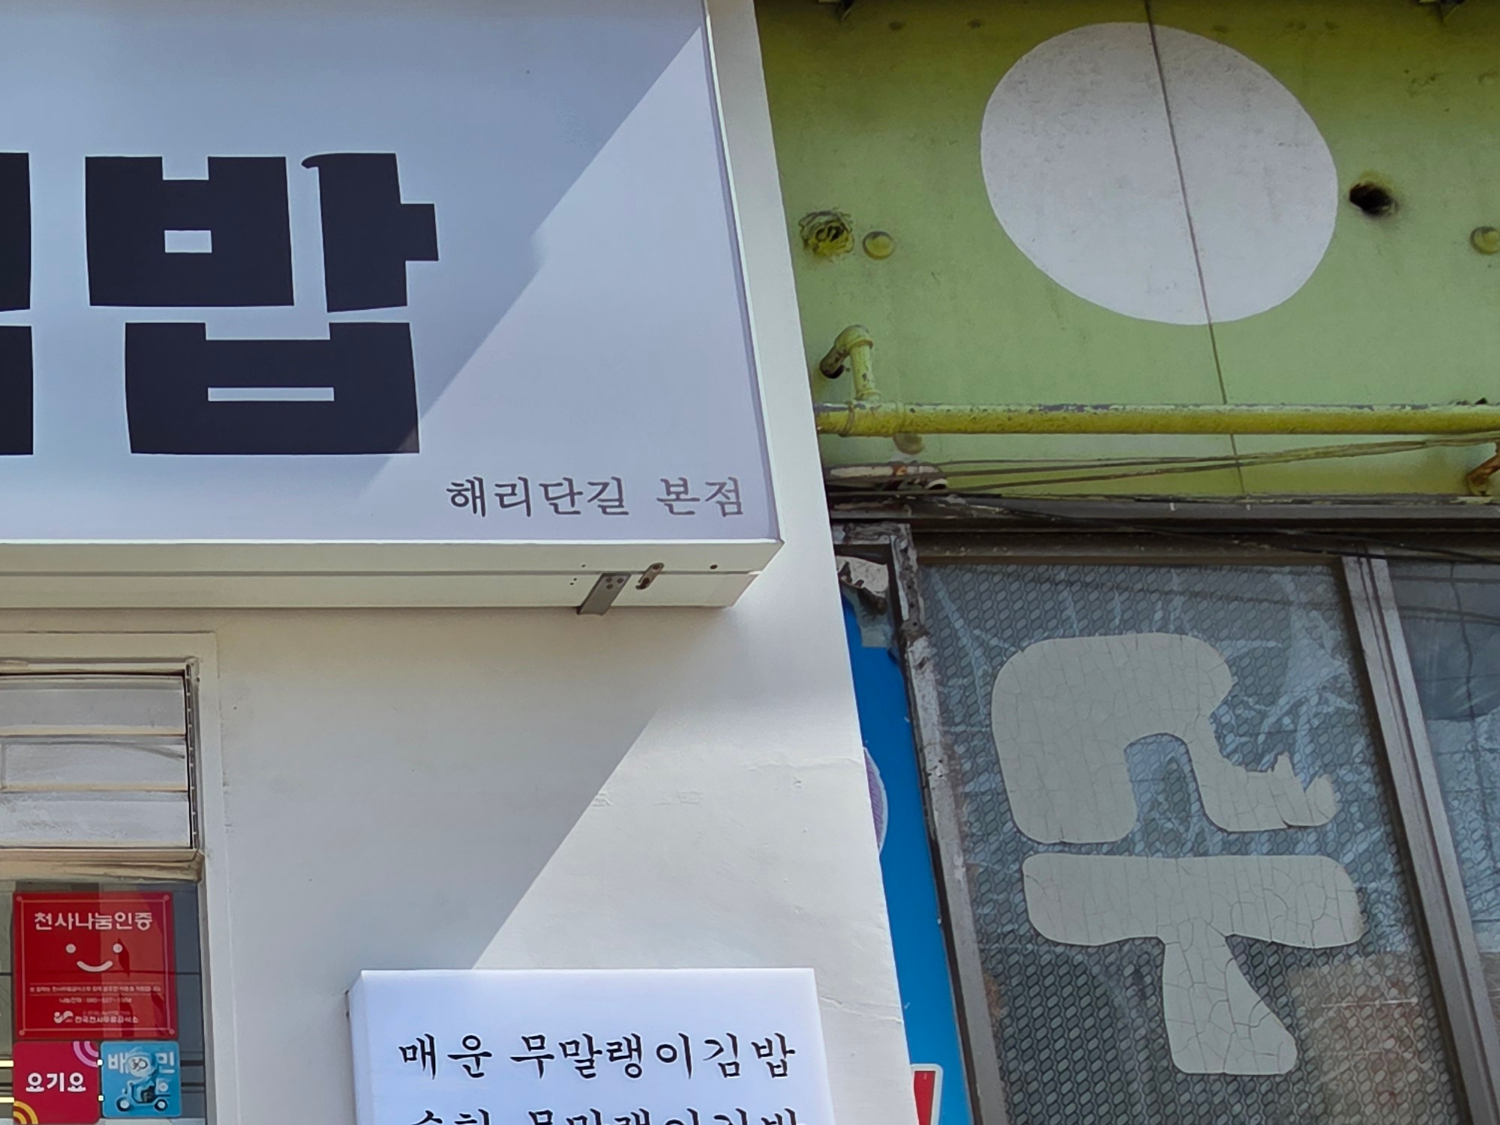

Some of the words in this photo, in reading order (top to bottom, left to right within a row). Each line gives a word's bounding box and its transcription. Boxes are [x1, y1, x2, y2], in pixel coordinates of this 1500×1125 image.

[446, 476, 630, 519] 해리단길
[656, 475, 746, 518] 본점
[33, 912, 153, 932] 천사나눔인증
[399, 1033, 492, 1079] 매운
[510, 1032, 796, 1080] 무말랭이김밥
[25, 1072, 87, 1093] 요기요
